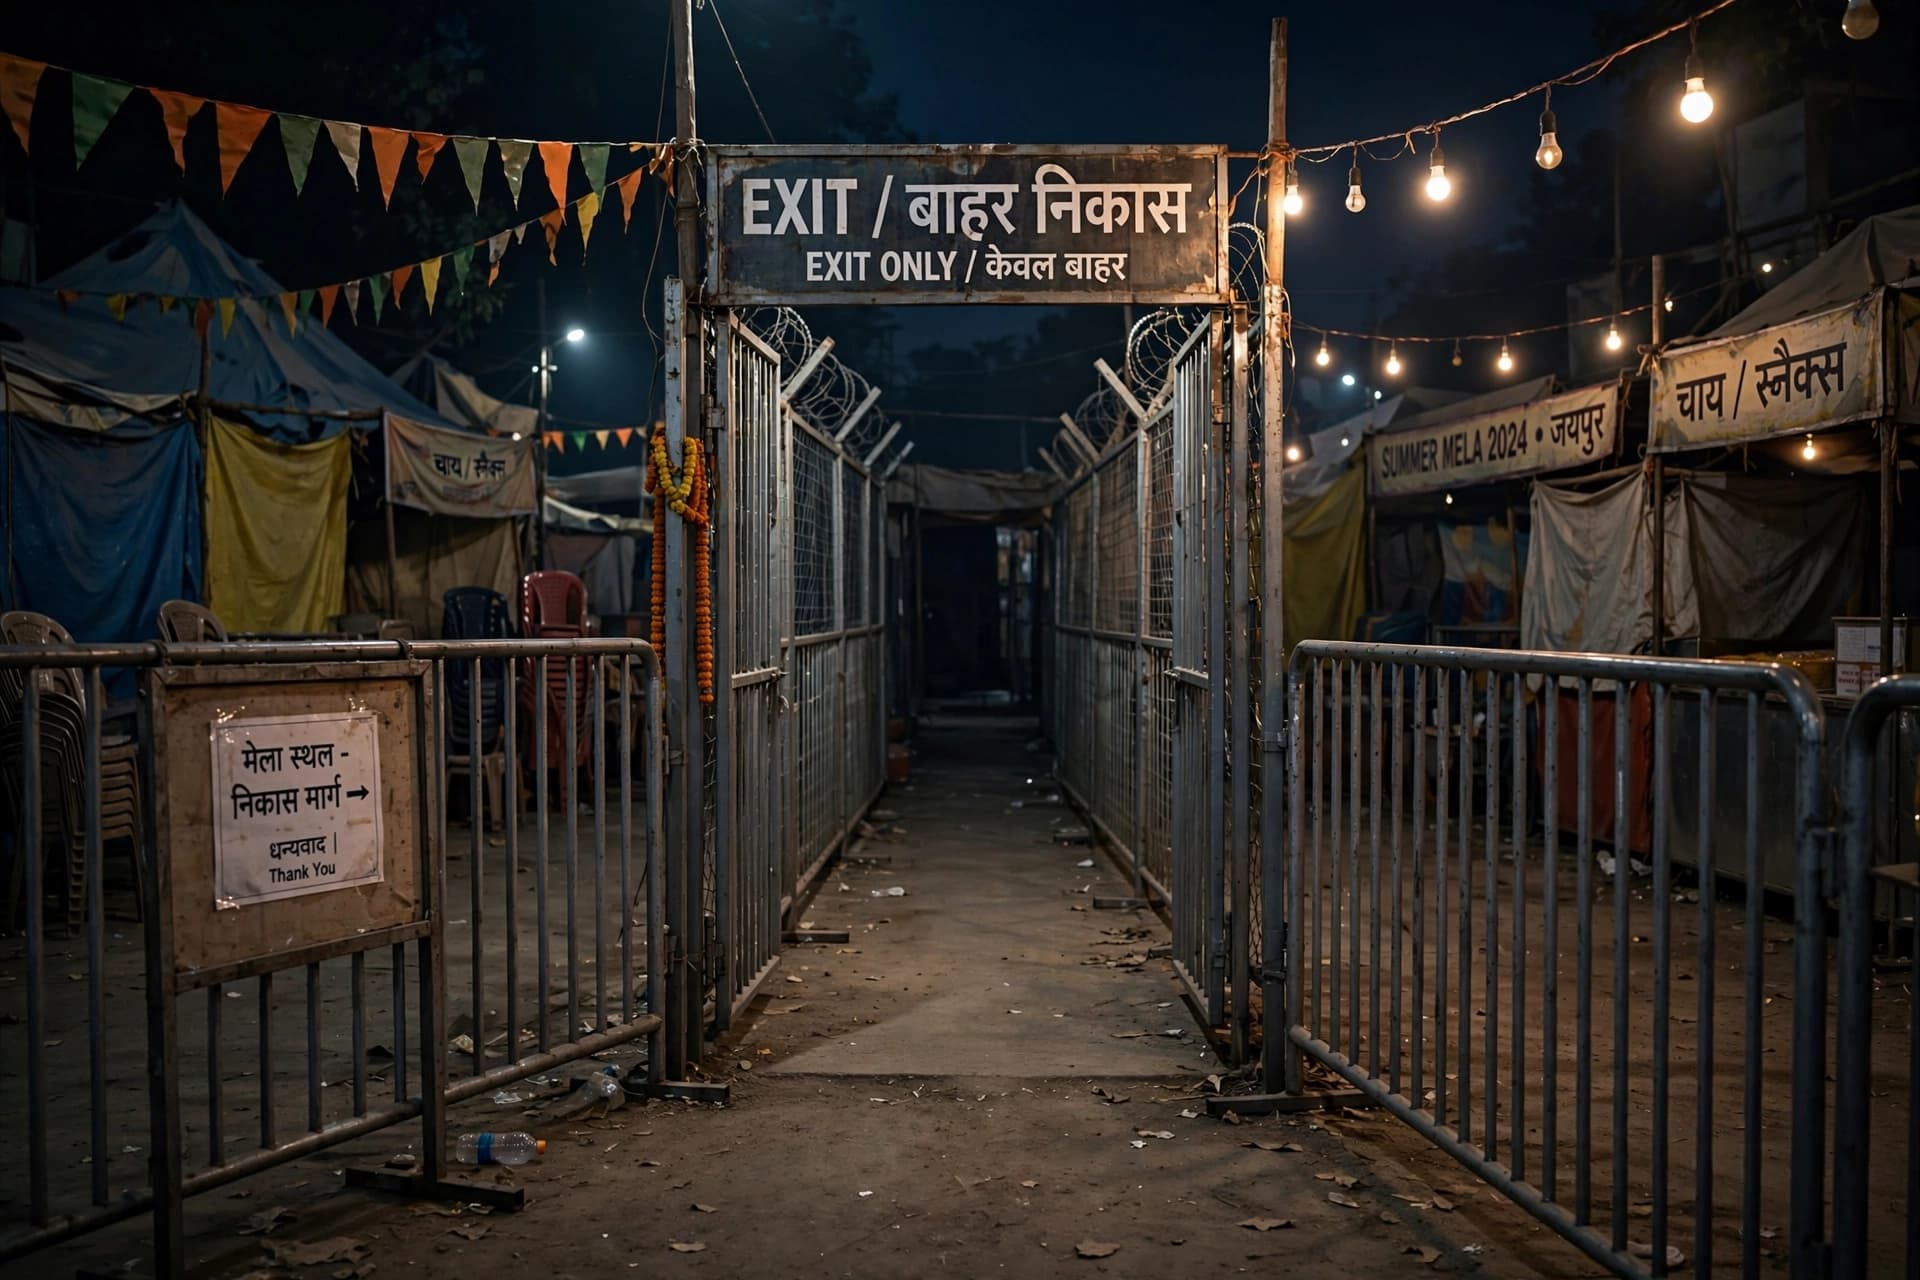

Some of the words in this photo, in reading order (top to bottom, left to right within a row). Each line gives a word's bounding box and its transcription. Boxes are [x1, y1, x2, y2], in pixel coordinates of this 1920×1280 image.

[742, 178, 858, 235] EXIT
[905, 183, 1019, 242] बाहर
[1032, 163, 1192, 234] निकास
[806, 251, 871, 281] EXIT
[880, 250, 957, 282] ONLY
[985, 244, 1054, 281] केवल
[1064, 252, 1128, 283] बाहर
[1676, 373, 1727, 421] चाय
[1755, 337, 1847, 408] स्नैक्स
[1382, 438, 1438, 478] SUMMER
[1442, 430, 1483, 469] MELA
[1488, 420, 1528, 461] 2024
[1550, 403, 1606, 455] जयपुर
[242, 741, 283, 773] मेला
[289, 744, 334, 769] स्थल
[231, 784, 299, 819] निकास
[304, 774, 341, 810] मार्ग
[270, 836, 327, 860] धन्यवाद
[269, 865, 309, 883] Thank
[314, 862, 336, 878] You
